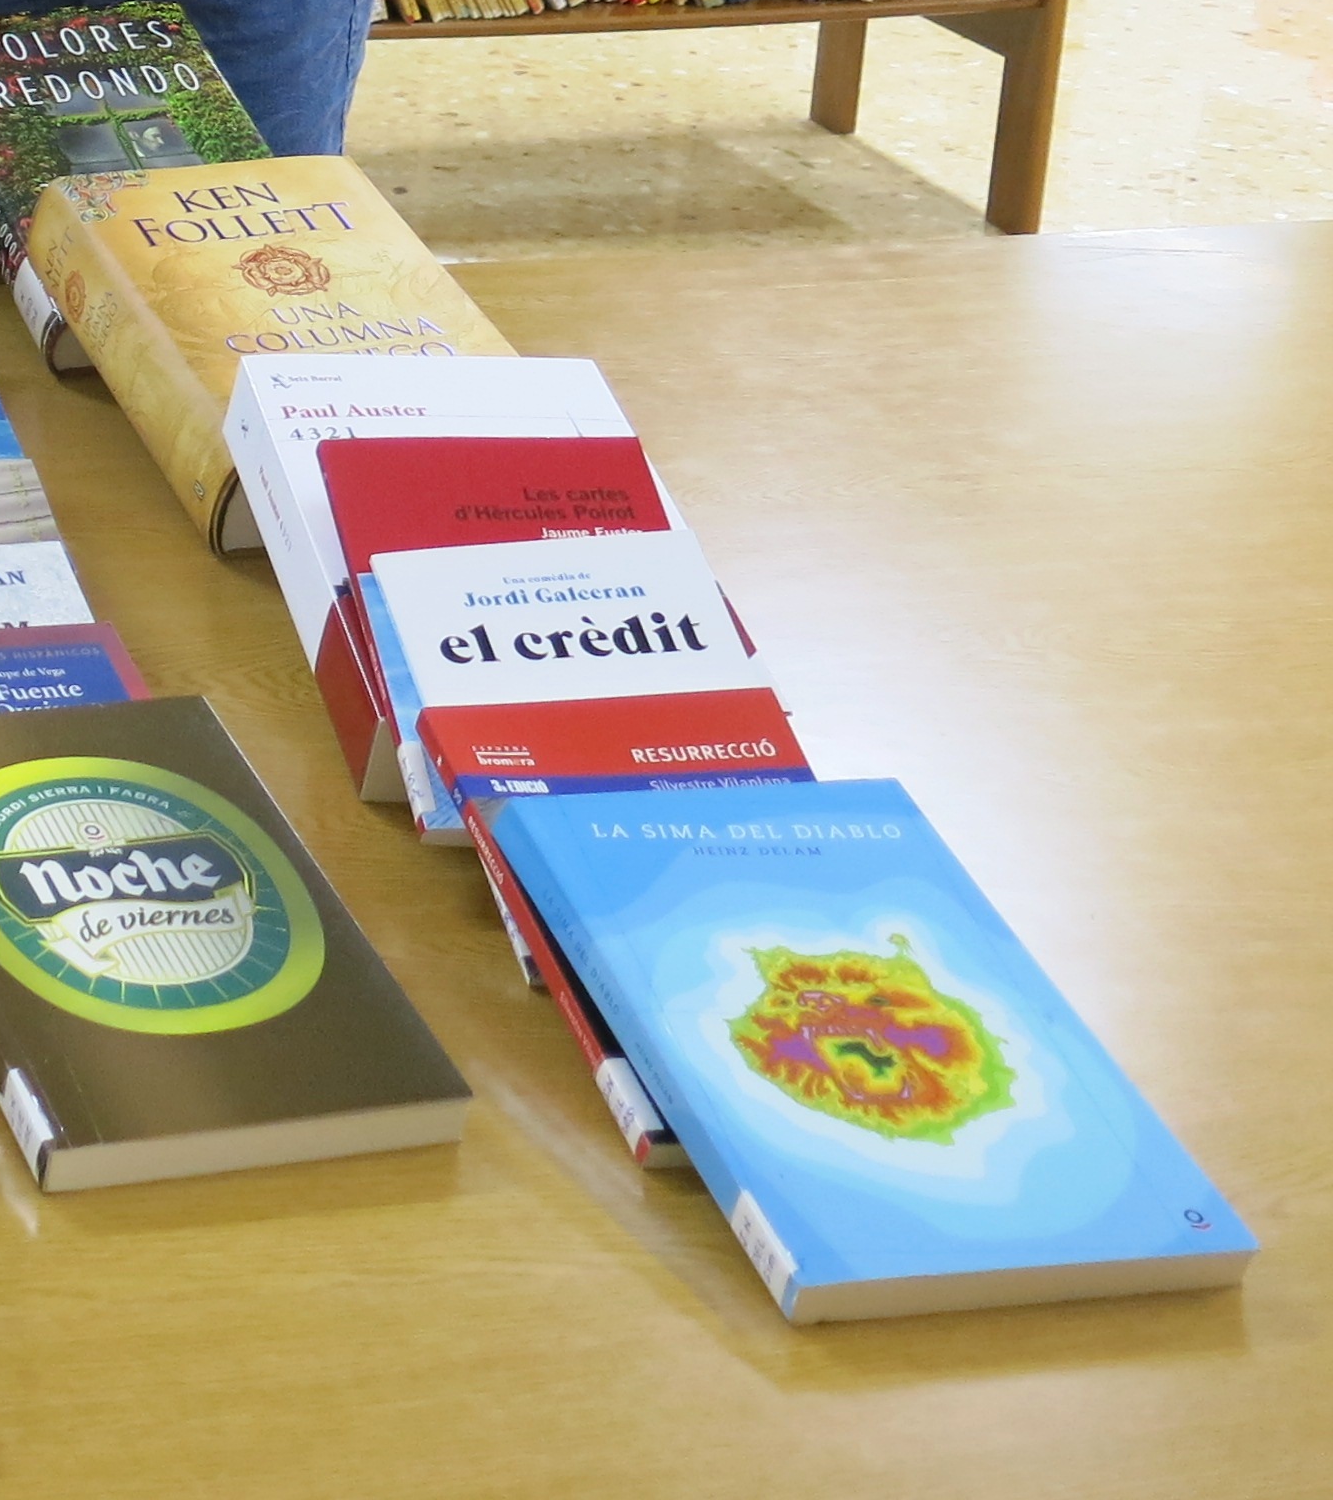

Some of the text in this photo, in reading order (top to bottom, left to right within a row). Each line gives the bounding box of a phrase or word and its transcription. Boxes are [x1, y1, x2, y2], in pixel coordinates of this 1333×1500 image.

[172, 182, 283, 211] KEN
[131, 201, 357, 247] FOLLETT
[271, 301, 360, 326] UNA
[225, 315, 447, 355] COLUMNA
[280, 402, 427, 420] Paul Auster
[523, 487, 629, 502] Les cartes
[572, 504, 636, 520] Poirot
[462, 582, 646, 608] Jordi Galceran
[440, 611, 709, 664] el crèdit
[22, 667, 37, 678] de
[39, 667, 66, 678] Vega
[631, 738, 777, 765] RESURRECCIÓ
[590, 821, 902, 841] LA SIMA DEL DIABLO
[693, 845, 750, 856] HEINZ
[18, 847, 222, 906] Noche
[78, 906, 236, 943] de viernes
